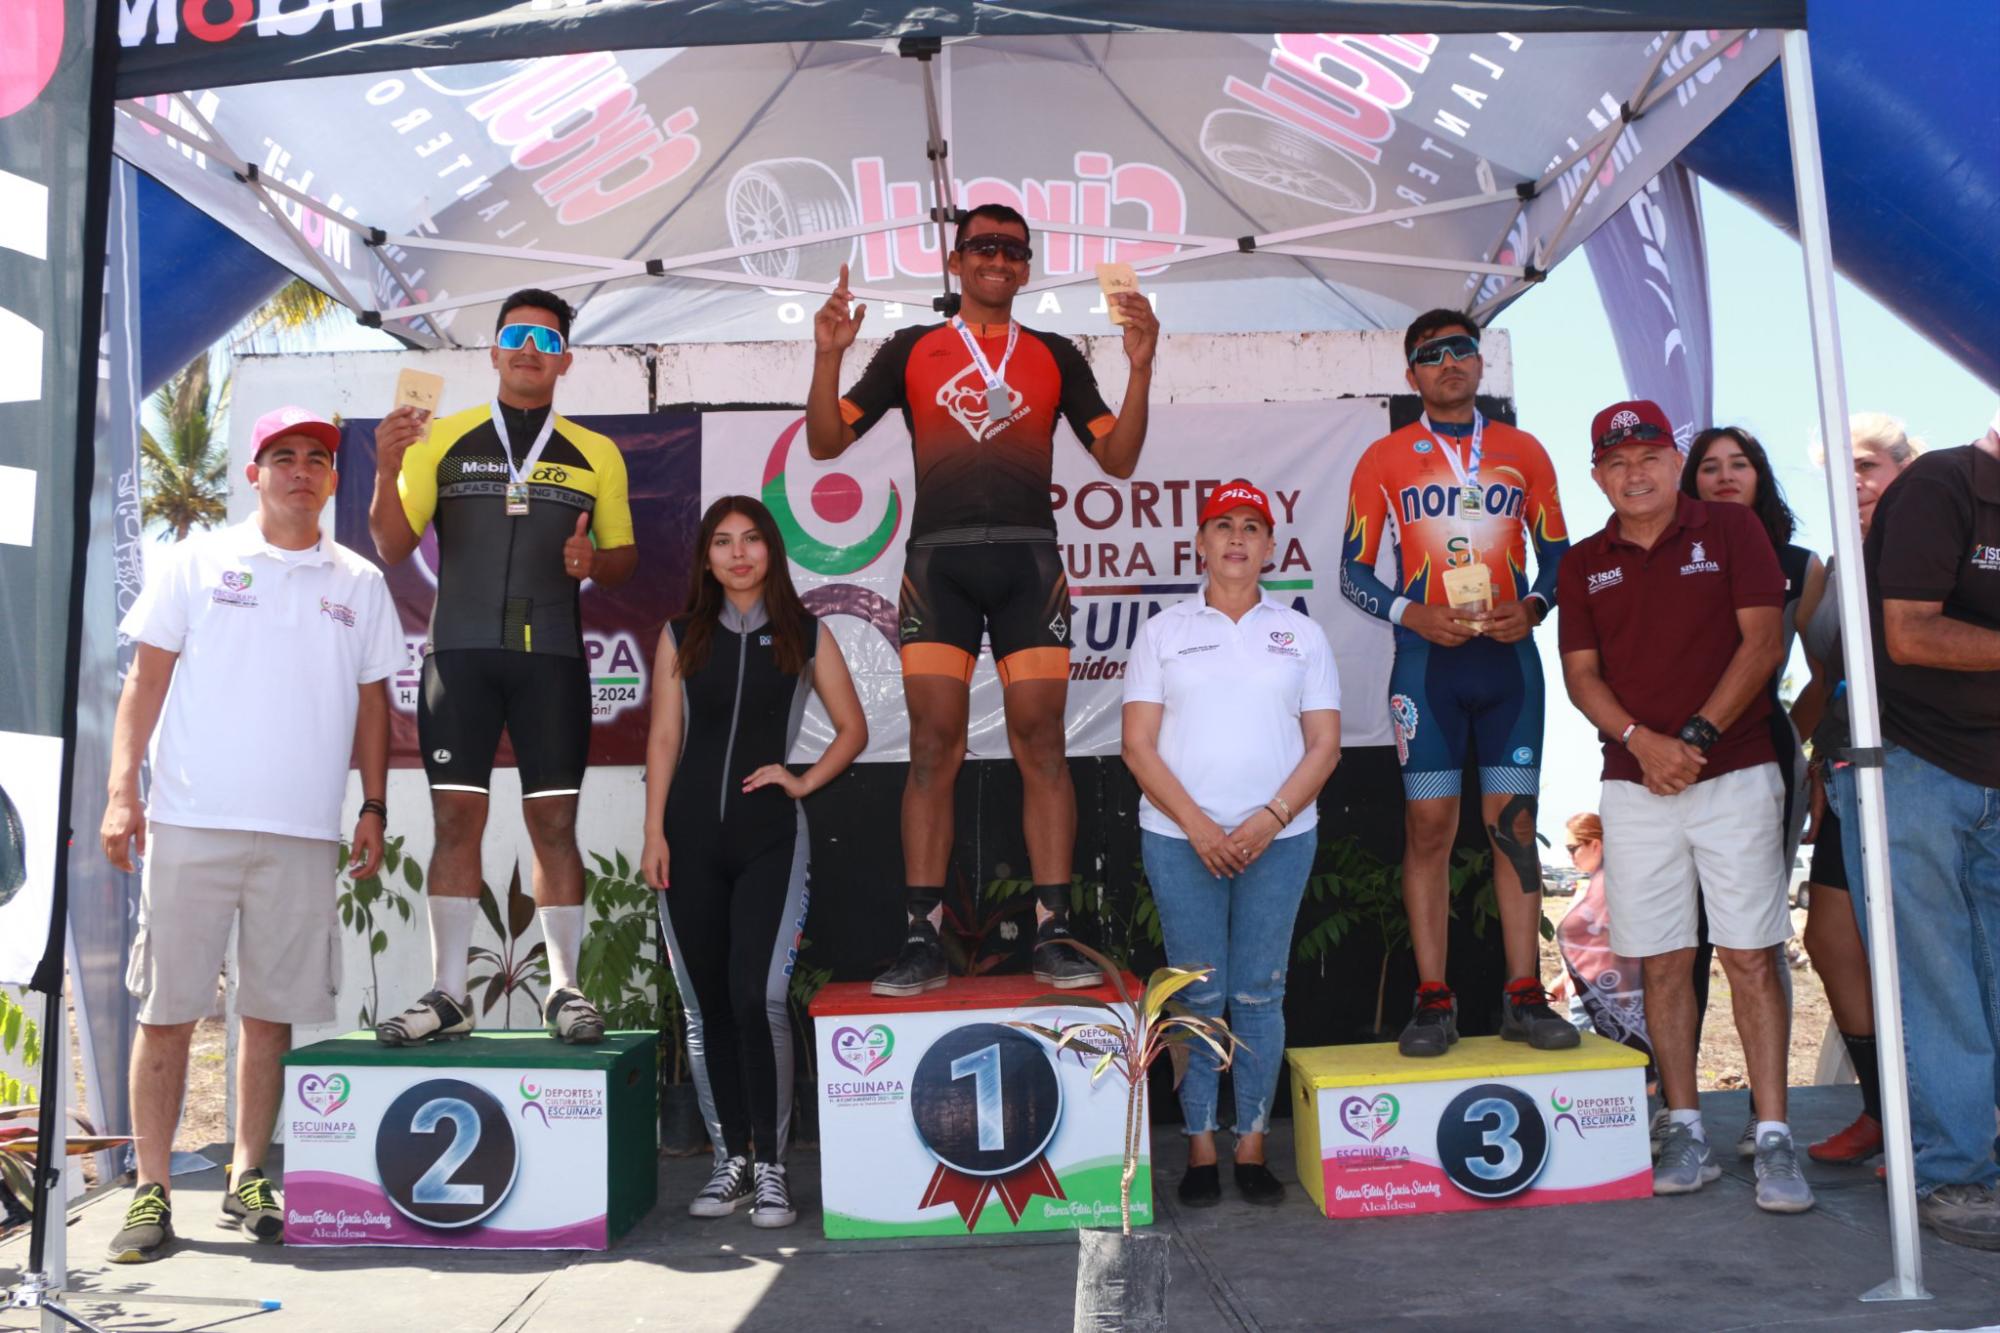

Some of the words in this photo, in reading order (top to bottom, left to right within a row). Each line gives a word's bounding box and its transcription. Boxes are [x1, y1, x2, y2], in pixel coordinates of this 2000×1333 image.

[462, 461, 509, 474] Mobil
[1276, 490, 1302, 524] Y
[1401, 483, 1525, 525] noron
[1069, 655, 1127, 681] nidos
[545, 1089, 593, 1098] DEPORTES
[597, 1089, 602, 1099] Y
[827, 1081, 904, 1095] ESCUINAPA
[951, 1043, 1005, 1151] 1
[1577, 1097, 1625, 1109] DEPORTES
[1628, 1096, 1634, 1105] Y
[548, 1106, 603, 1116] ESCUINAPA
[292, 1121, 356, 1132] ESCUINAPA
[1581, 1114, 1636, 1126] ESCUINAPA
[1464, 1097, 1523, 1181] 3
[410, 1096, 484, 1204] 2
[1336, 1146, 1410, 1159] ESCUINAPA
[1360, 1200, 1416, 1213] Alcaldesa
[311, 1228, 366, 1239] Alcaldesa
